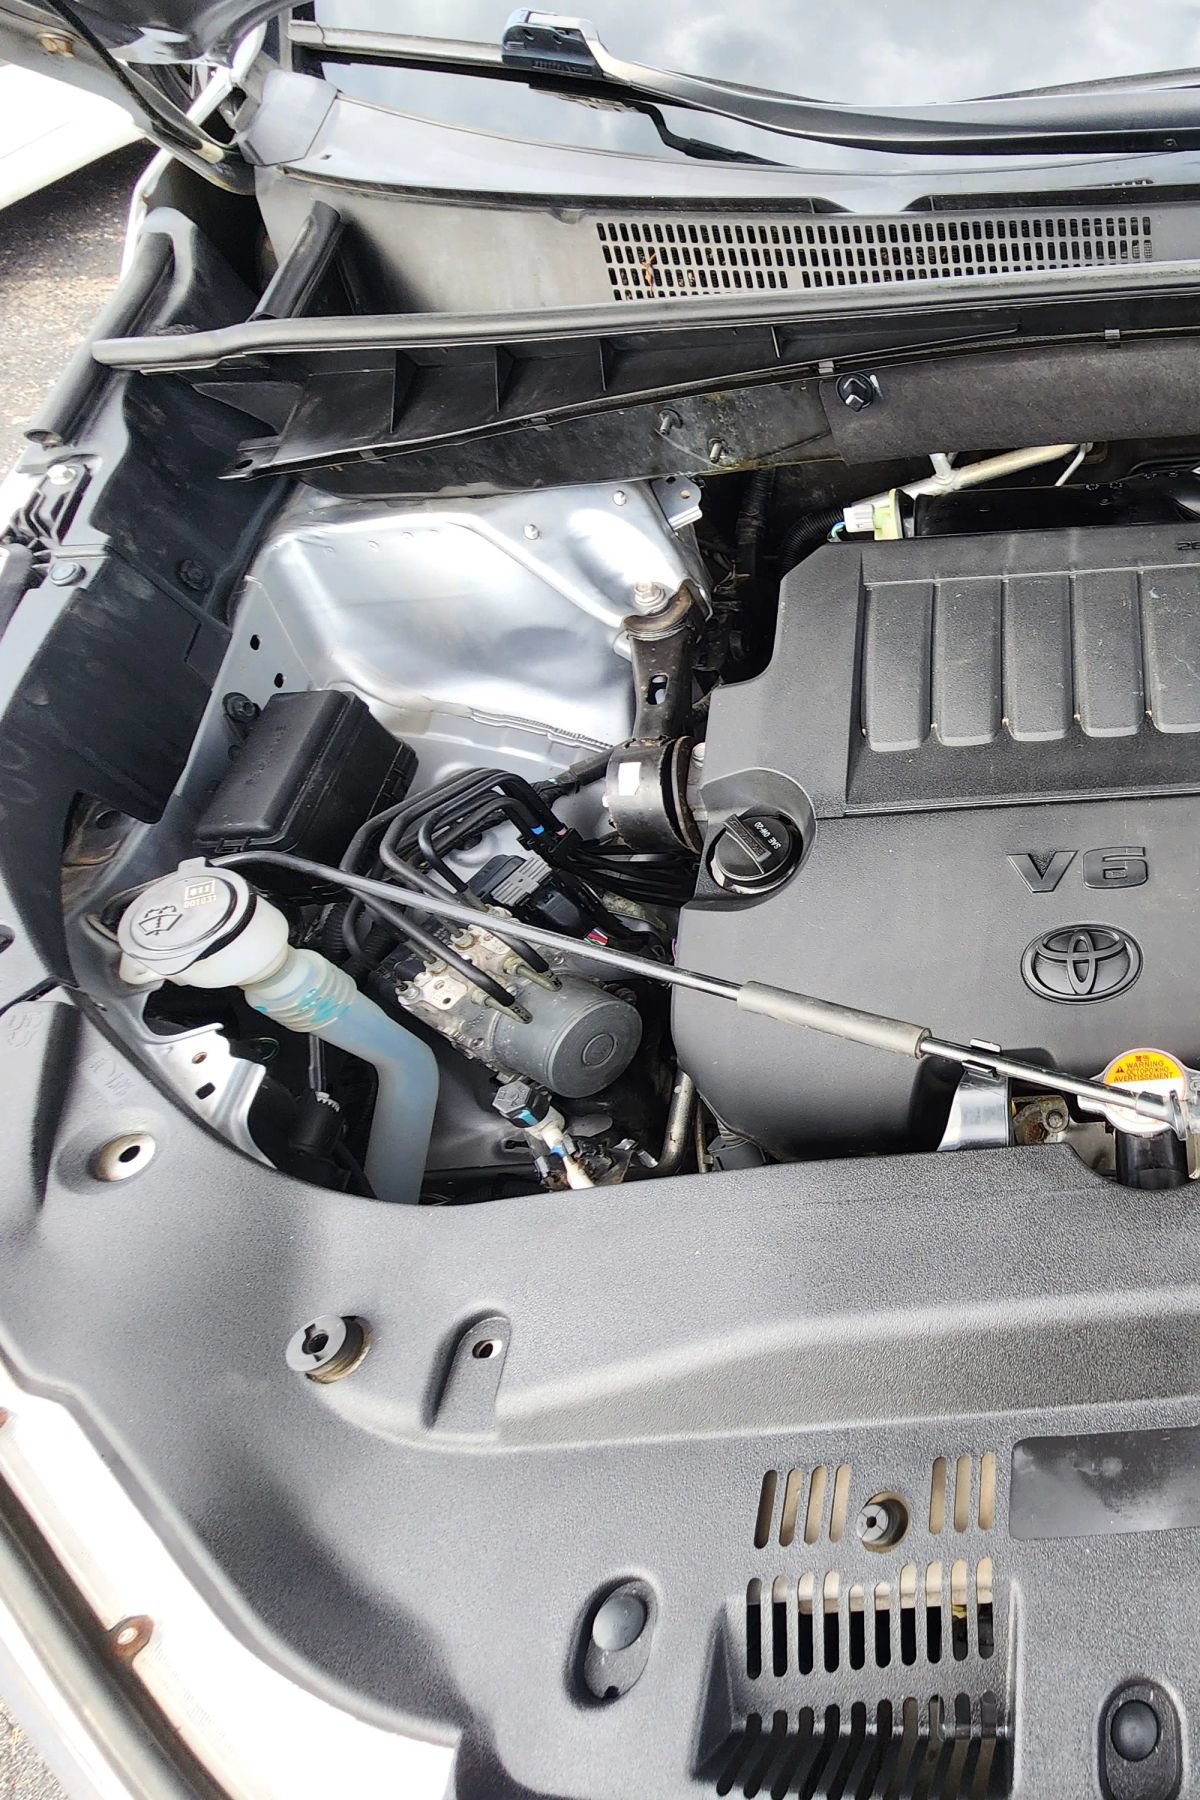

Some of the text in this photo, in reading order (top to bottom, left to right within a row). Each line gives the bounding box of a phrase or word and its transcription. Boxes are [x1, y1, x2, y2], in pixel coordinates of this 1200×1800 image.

[1006, 846, 1149, 893] V6
[1126, 1060, 1164, 1070] WARNING
[1113, 1072, 1174, 1083] AVERTISSEMENT
